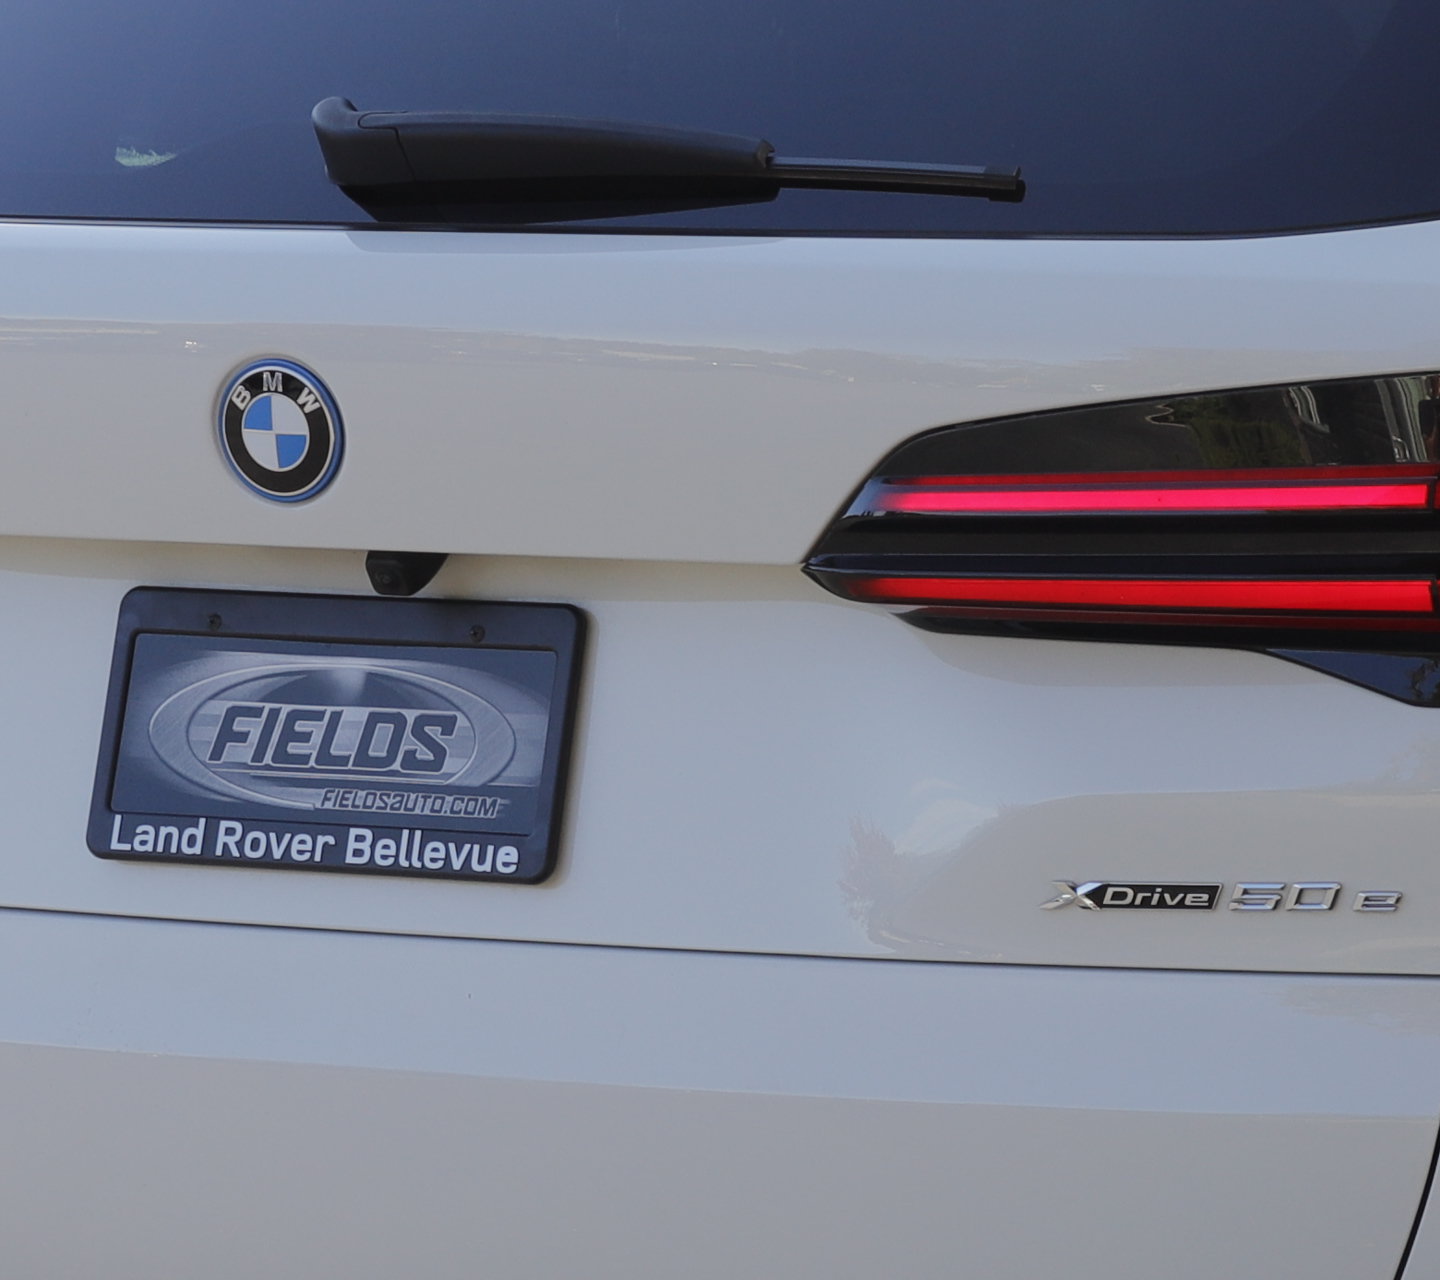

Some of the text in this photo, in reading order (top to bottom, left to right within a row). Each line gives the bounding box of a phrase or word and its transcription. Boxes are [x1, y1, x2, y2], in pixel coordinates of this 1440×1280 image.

[231, 371, 321, 414] BMW
[207, 704, 458, 775] FIELDS
[109, 814, 520, 875] Land Rover Bellevue
